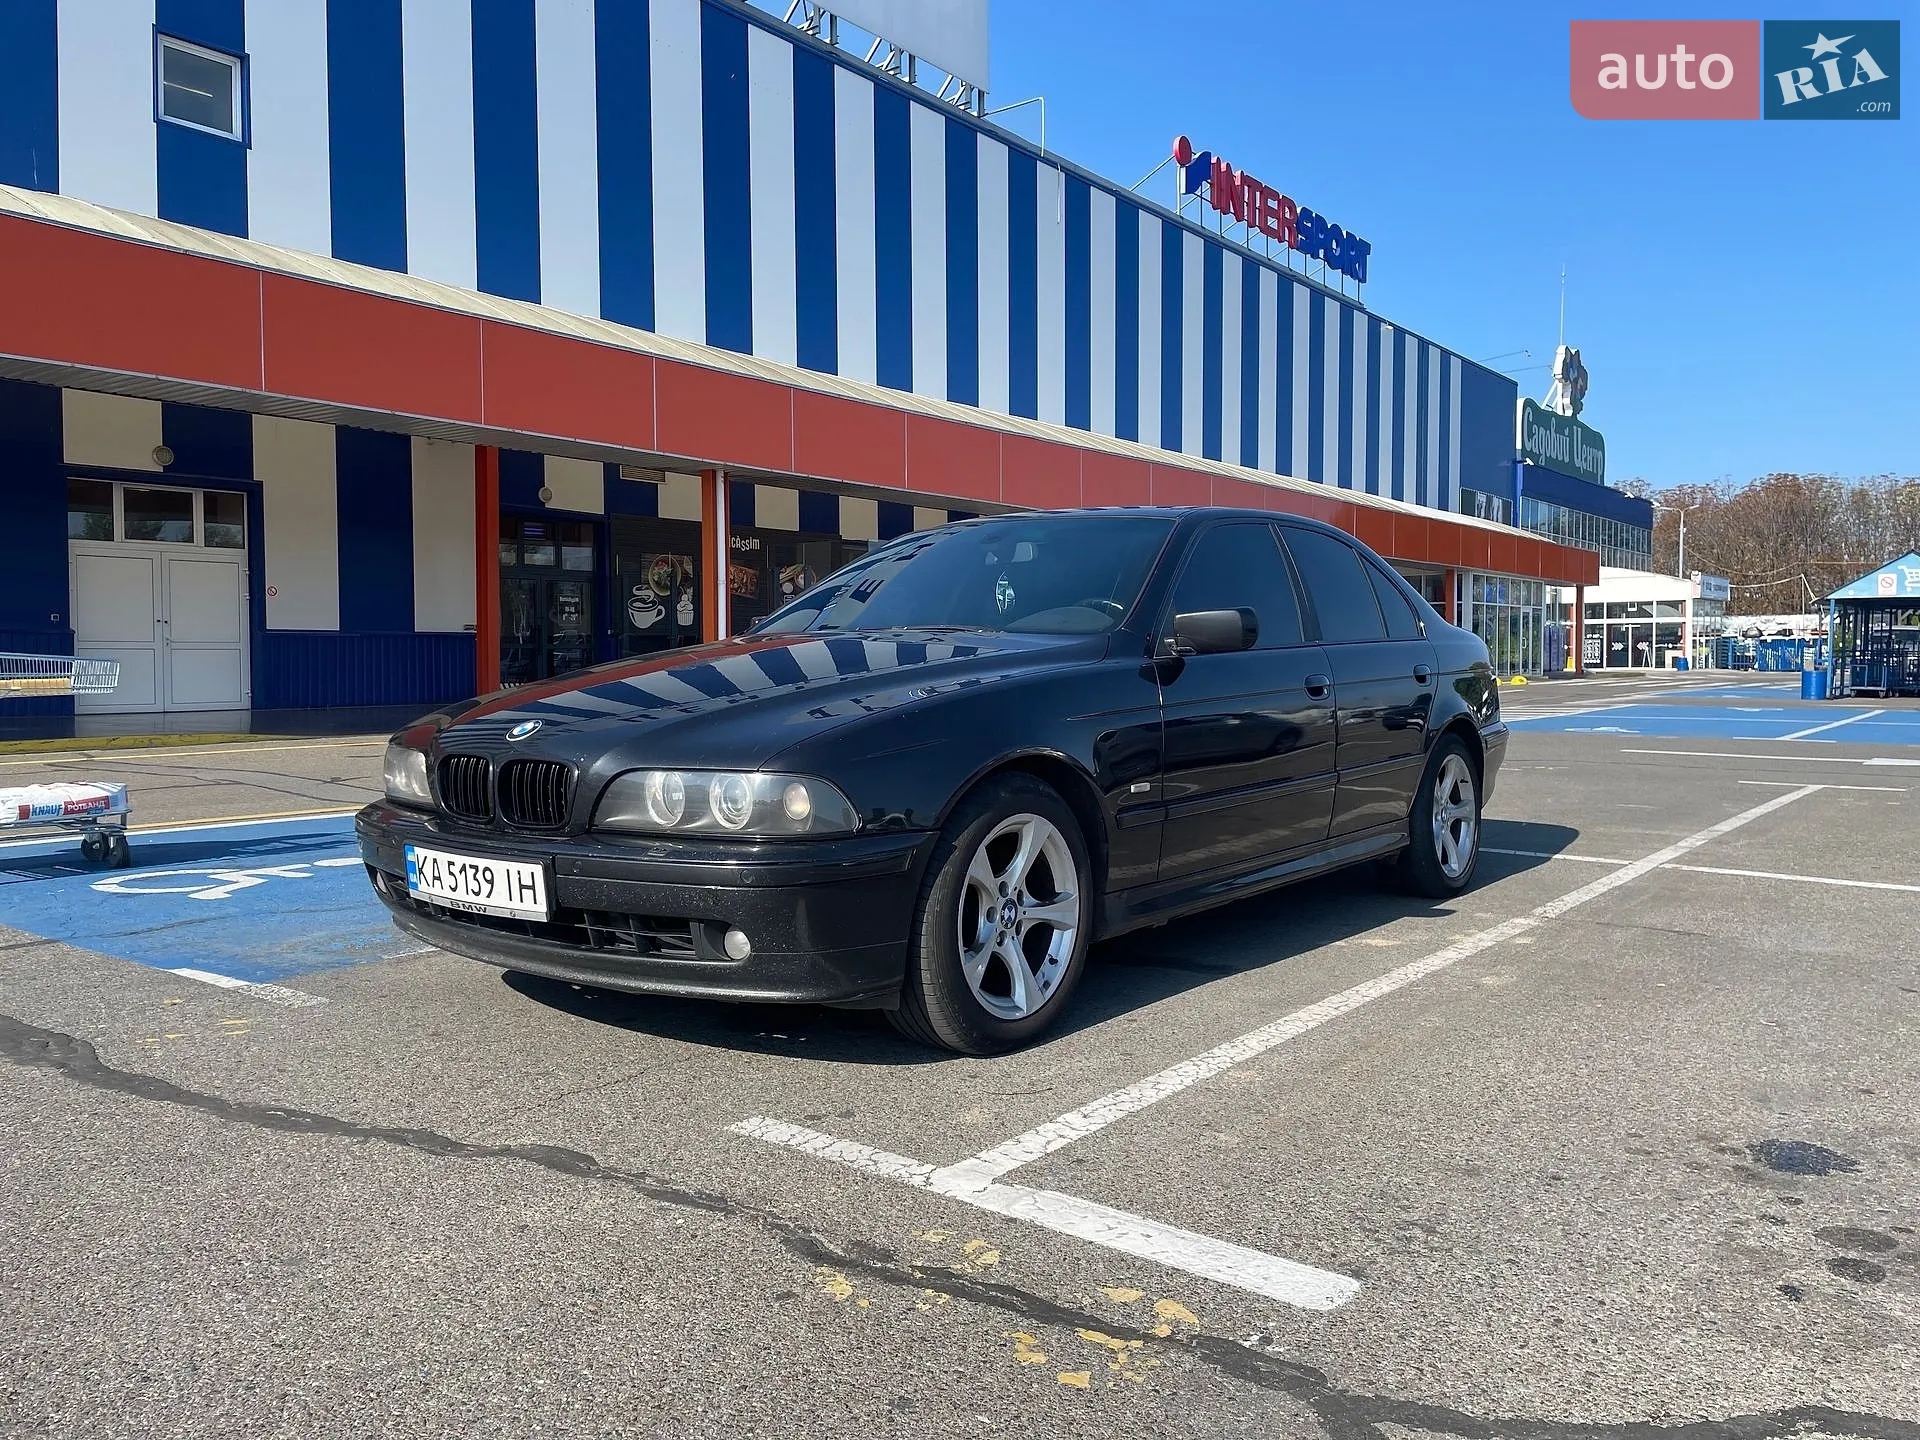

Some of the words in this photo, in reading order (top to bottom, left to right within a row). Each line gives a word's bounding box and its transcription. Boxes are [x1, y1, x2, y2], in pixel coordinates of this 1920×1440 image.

[1211, 156, 1372, 284] INTERSPORT
[1523, 406, 1570, 466] Садовий
[1573, 425, 1603, 485] Центр
[31, 804, 63, 817] KNAUF
[416, 854, 443, 890] KA
[447, 860, 494, 898] 5139
[506, 868, 538, 905] IH
[450, 901, 488, 914] BMW
